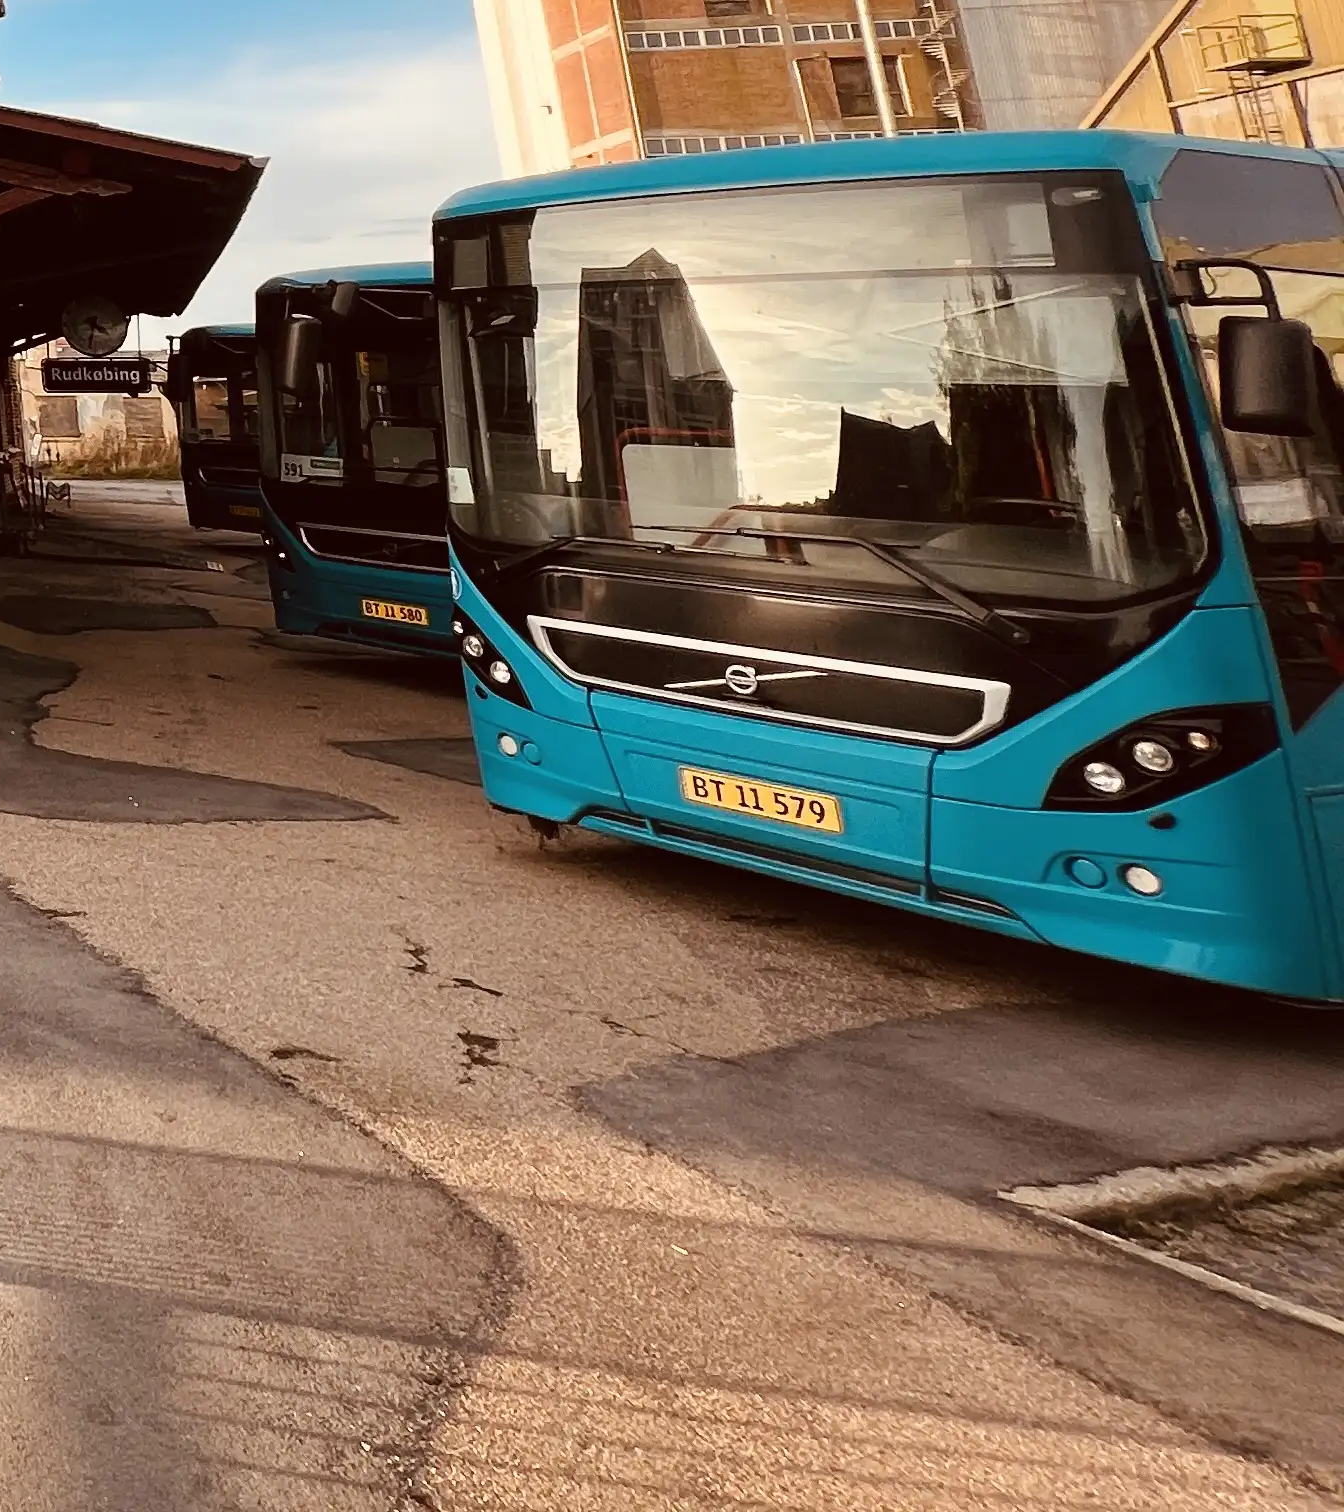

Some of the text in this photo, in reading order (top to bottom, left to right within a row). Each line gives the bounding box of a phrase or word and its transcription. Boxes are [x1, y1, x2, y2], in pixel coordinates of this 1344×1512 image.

[51, 367, 140, 384] Rudkøbing
[284, 462, 303, 477] 591
[365, 601, 423, 622] BT 11 580
[692, 775, 825, 824] BT 11 579
